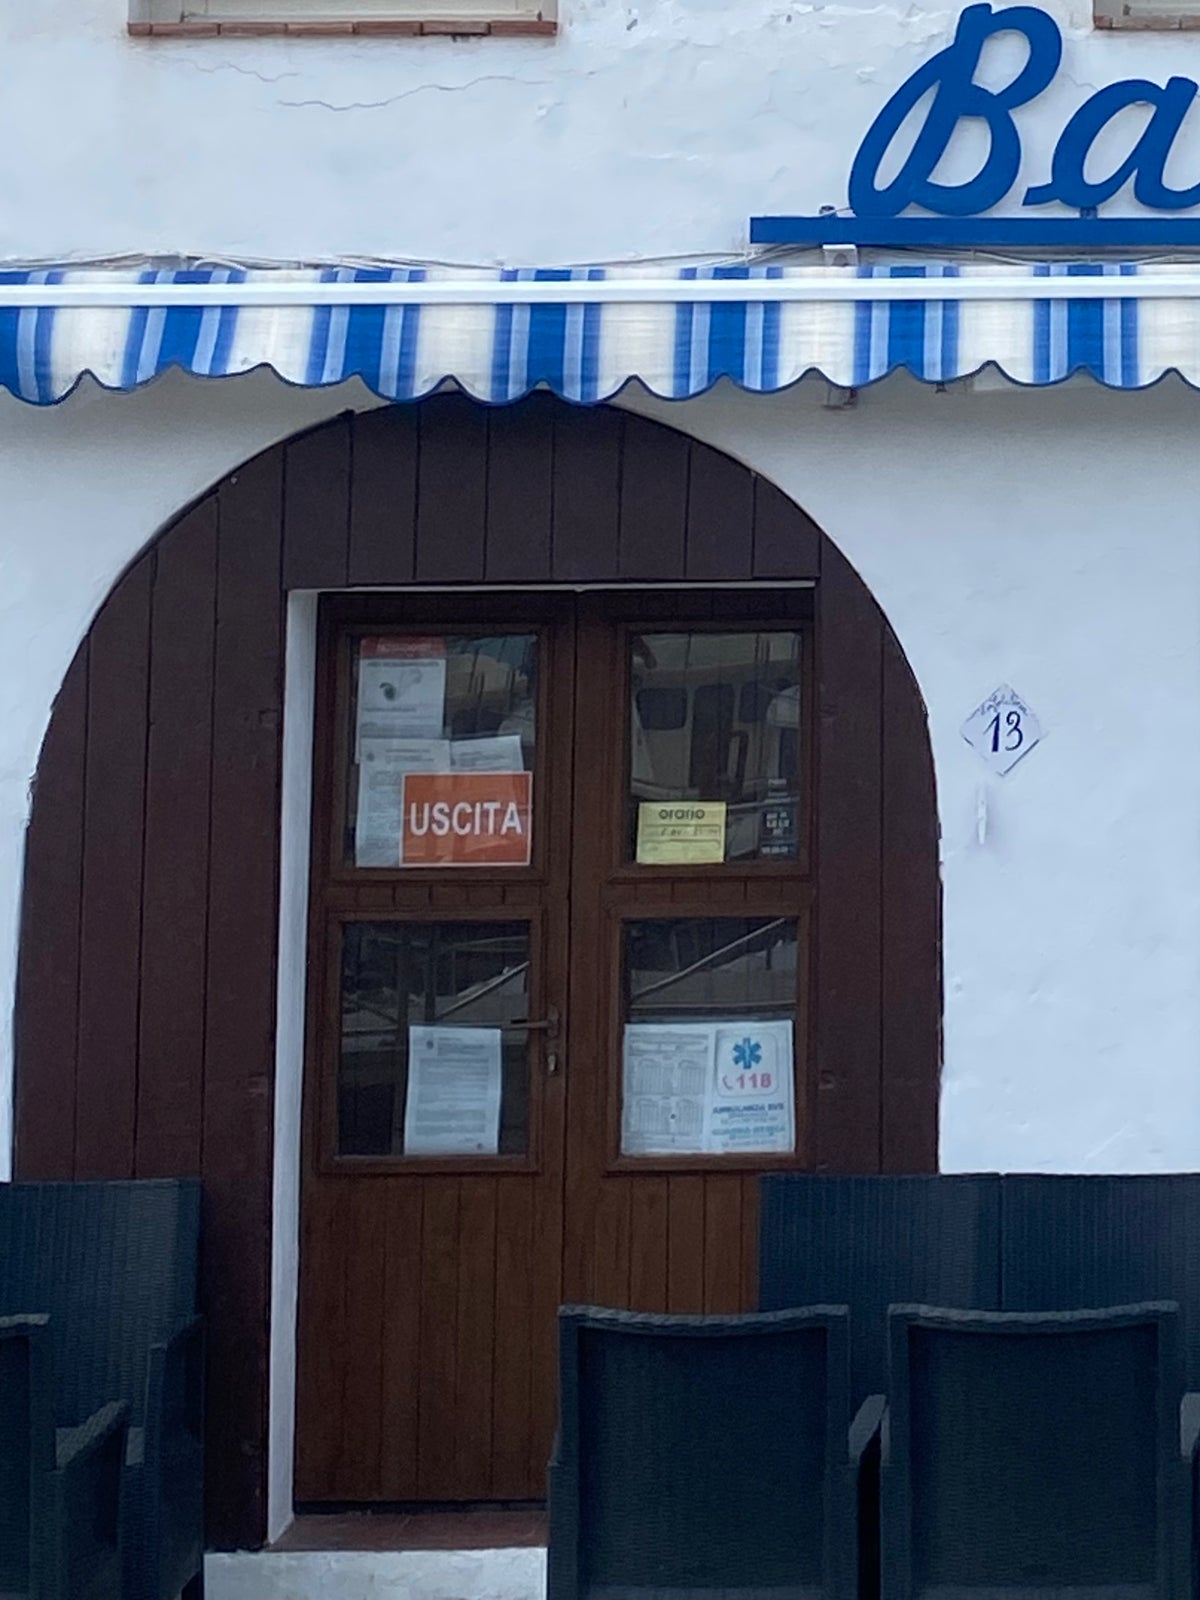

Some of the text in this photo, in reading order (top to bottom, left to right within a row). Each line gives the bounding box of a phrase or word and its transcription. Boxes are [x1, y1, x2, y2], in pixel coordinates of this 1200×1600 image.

[982, 711, 1024, 752] 13
[410, 802, 523, 836] USCITA
[658, 807, 706, 821] orario
[736, 1073, 772, 1089] 118
